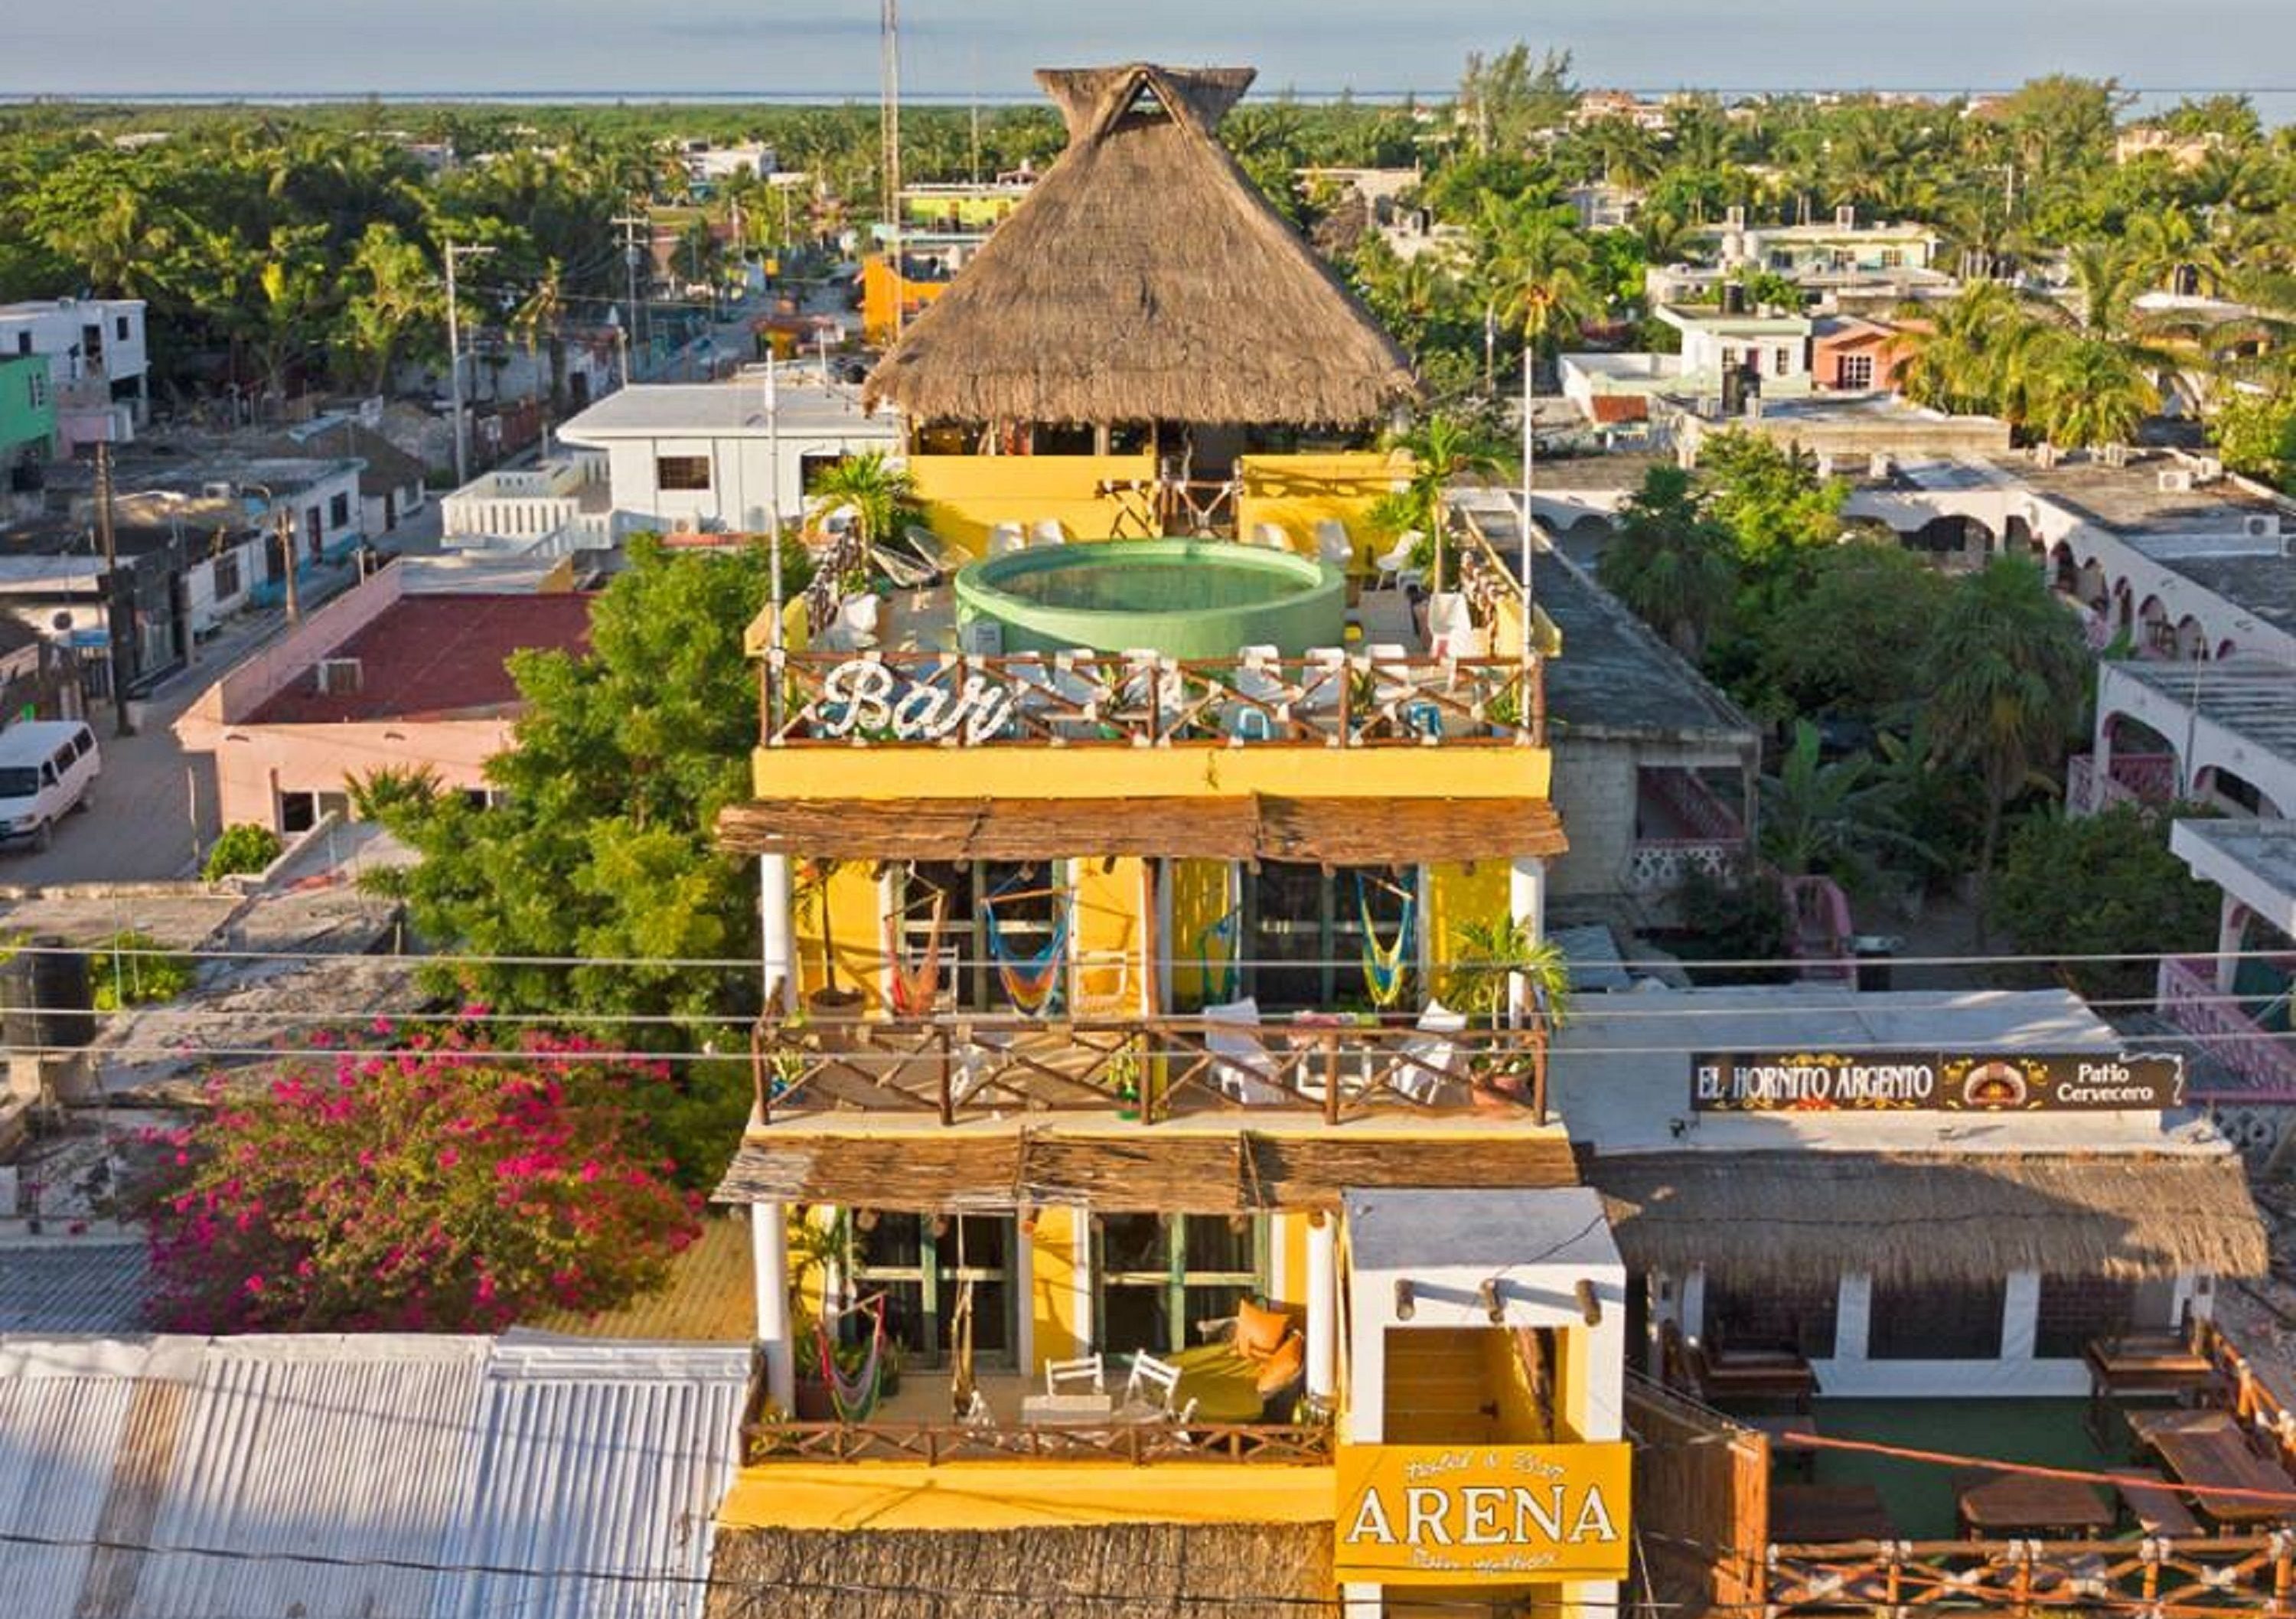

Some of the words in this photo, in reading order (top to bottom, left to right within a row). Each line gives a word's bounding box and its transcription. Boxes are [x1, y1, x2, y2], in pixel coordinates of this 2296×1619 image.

[823, 658, 1012, 743] Bar
[1698, 1067, 1723, 1098] EL
[1733, 1067, 1831, 1098] HORNITO
[1836, 1066, 1934, 1098] ARGENTO
[2078, 1062, 2130, 1083] Patio
[2057, 1082, 2154, 1102] Cervecero
[1345, 1485, 1619, 1544] ARENA
